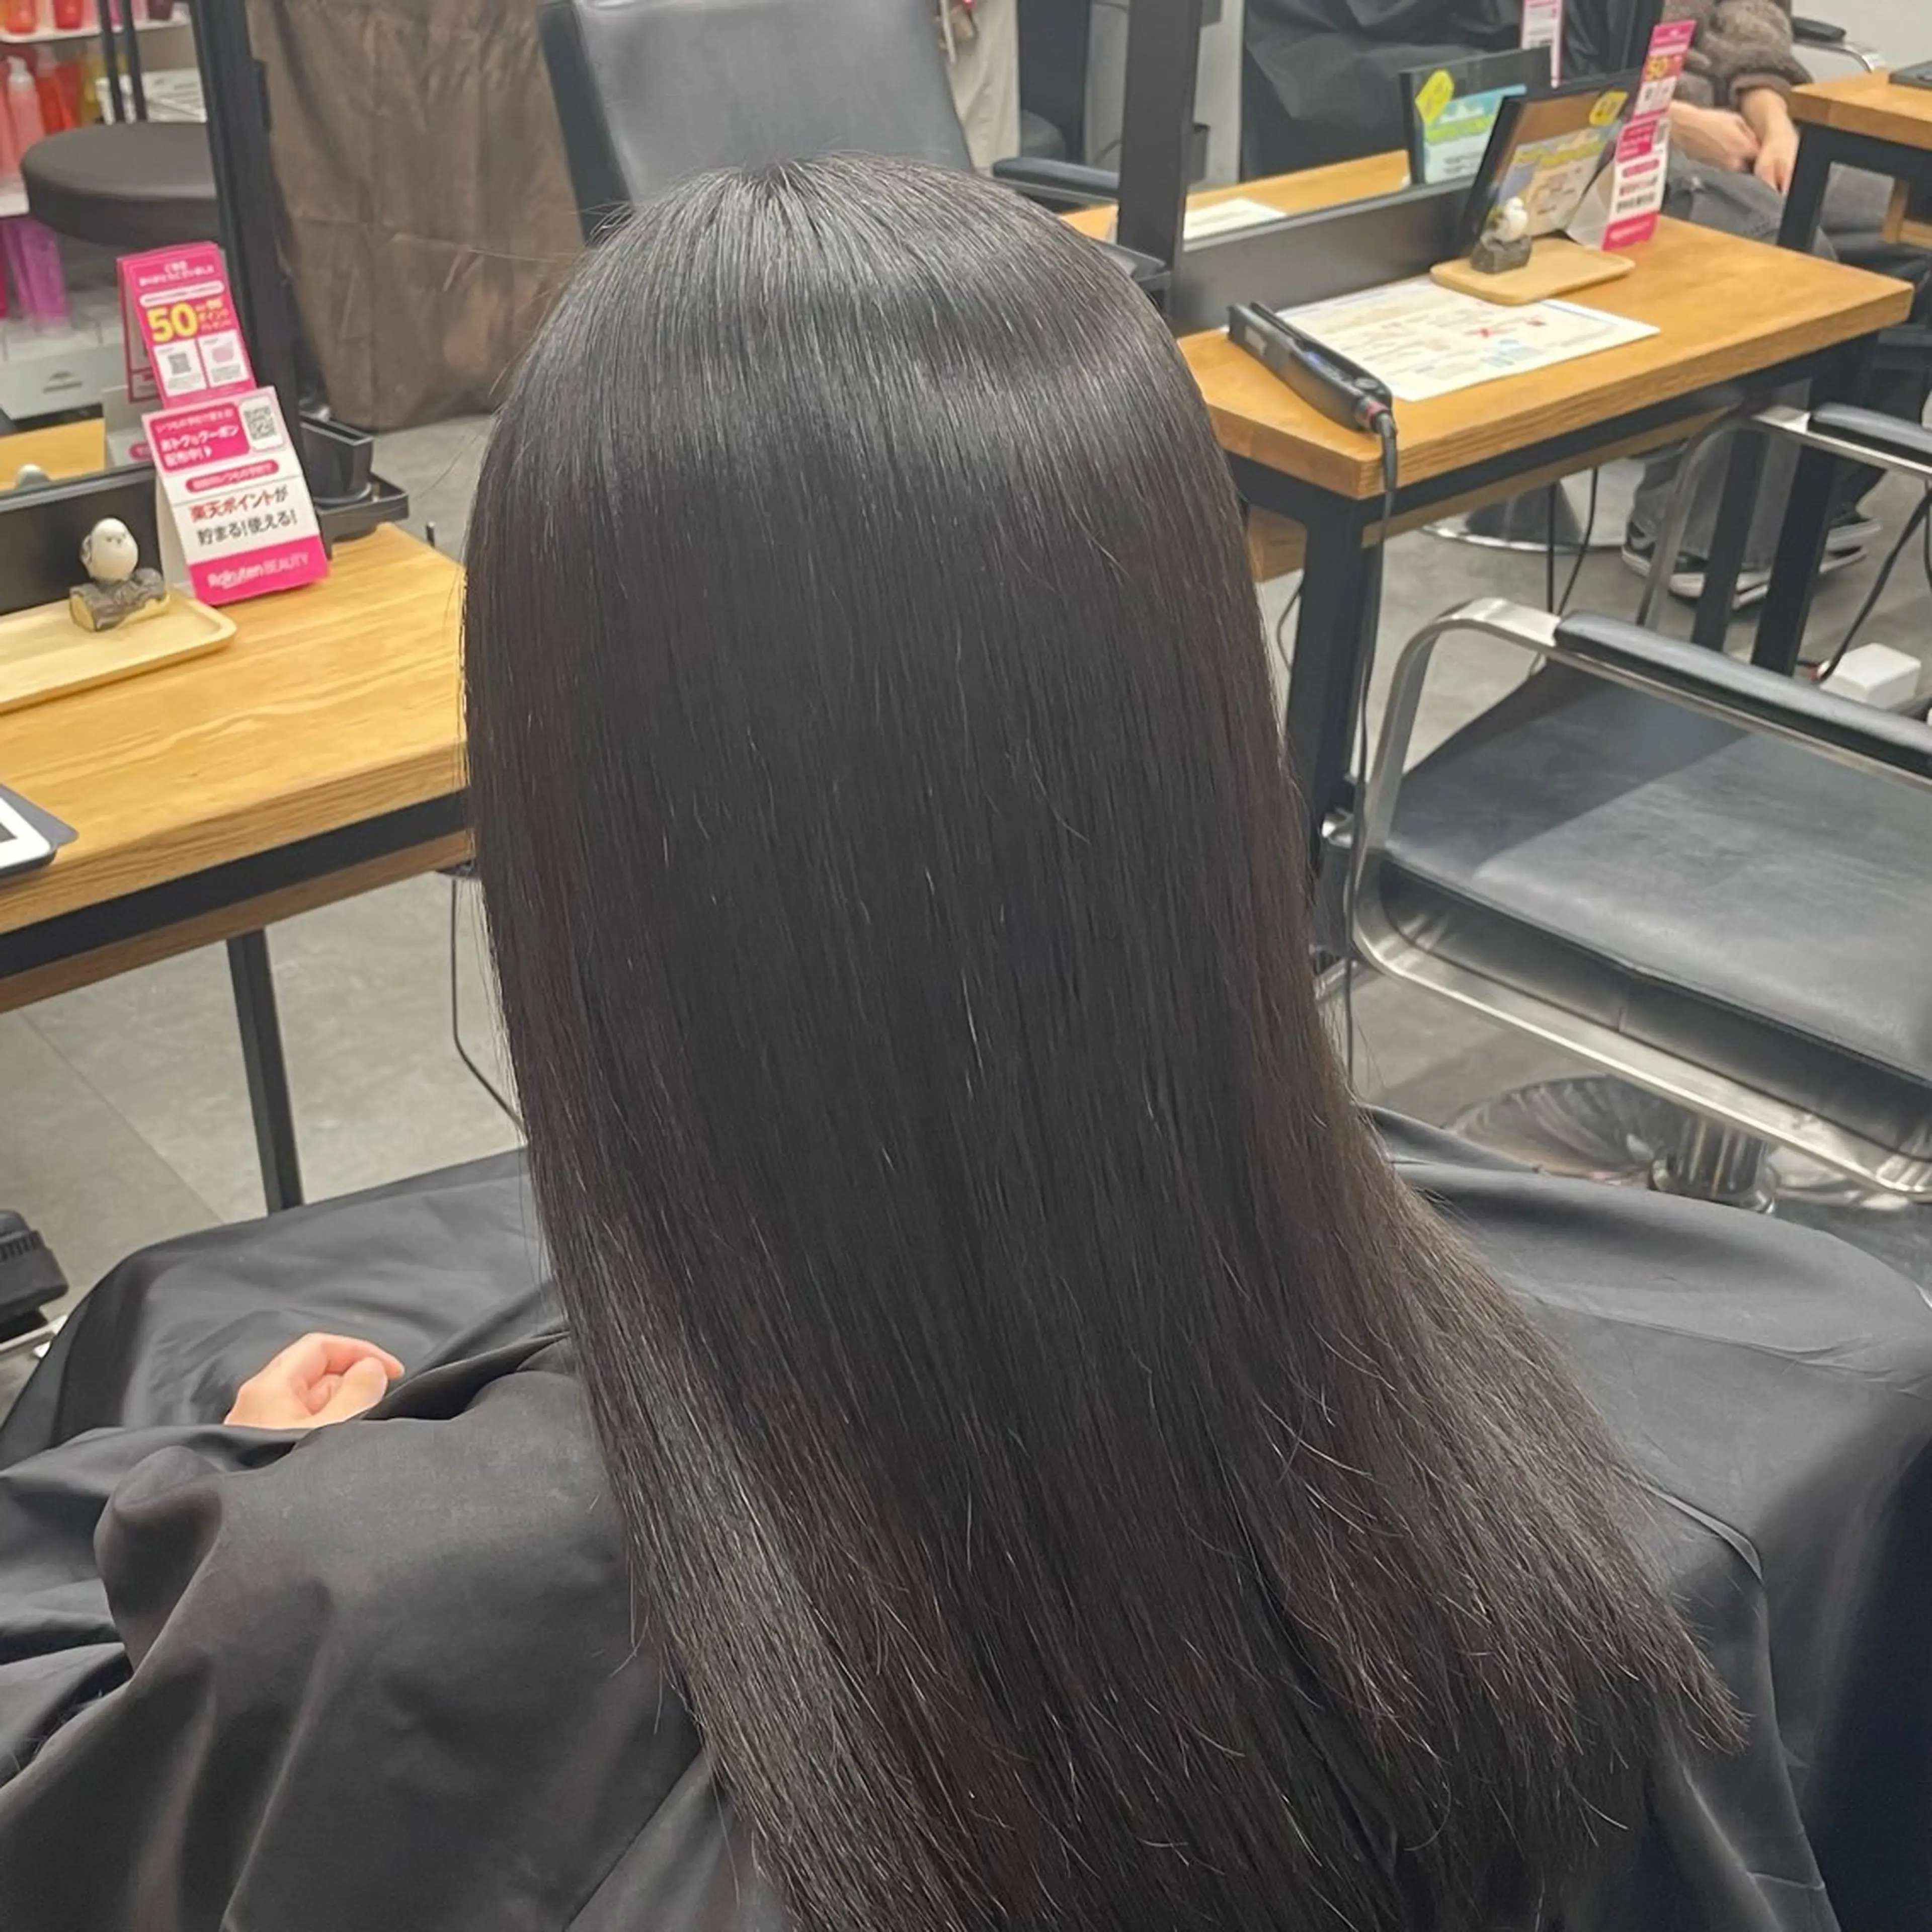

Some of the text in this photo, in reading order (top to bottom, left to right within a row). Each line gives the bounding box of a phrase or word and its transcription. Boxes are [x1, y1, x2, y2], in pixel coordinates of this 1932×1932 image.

[147, 301, 198, 342] 50
[191, 485, 288, 523] 楽天ポイントが
